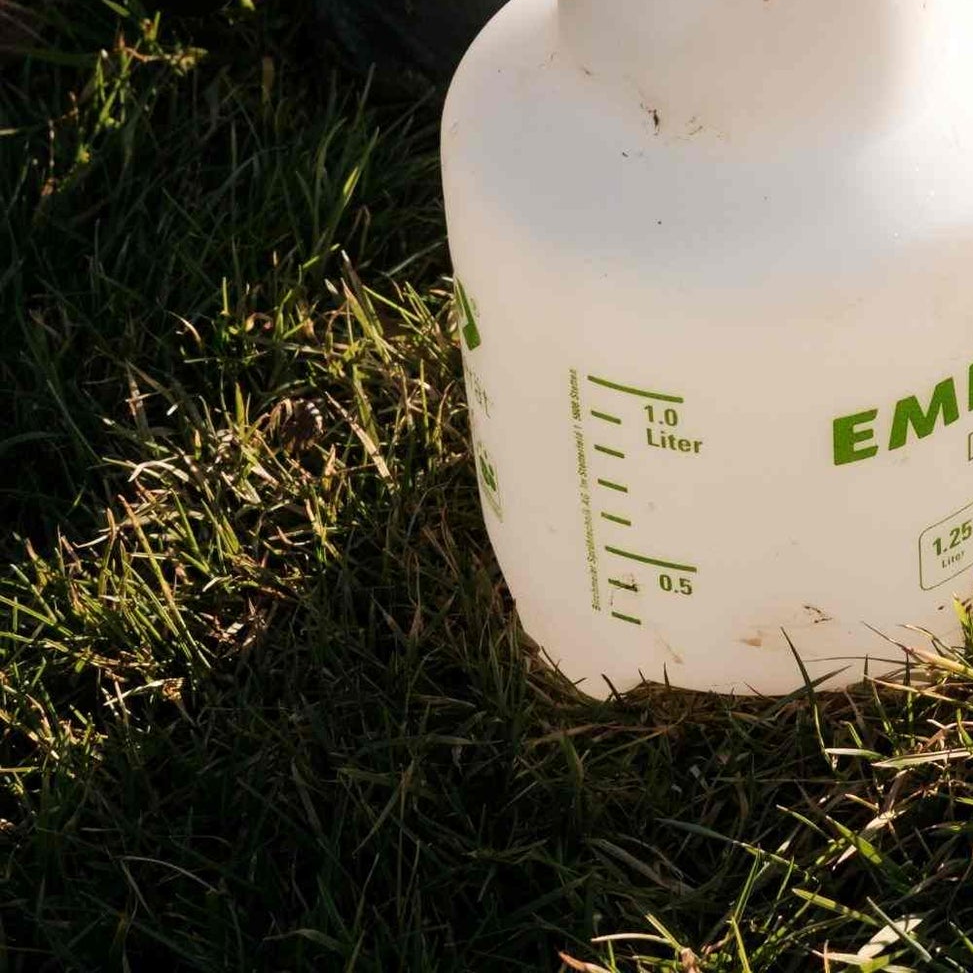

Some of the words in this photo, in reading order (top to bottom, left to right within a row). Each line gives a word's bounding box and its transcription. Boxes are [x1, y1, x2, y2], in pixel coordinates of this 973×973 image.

[643, 404, 678, 427] 1.0
[645, 428, 703, 454] Liter
[932, 519, 973, 557] 1.25
[659, 574, 693, 596] 0.5
